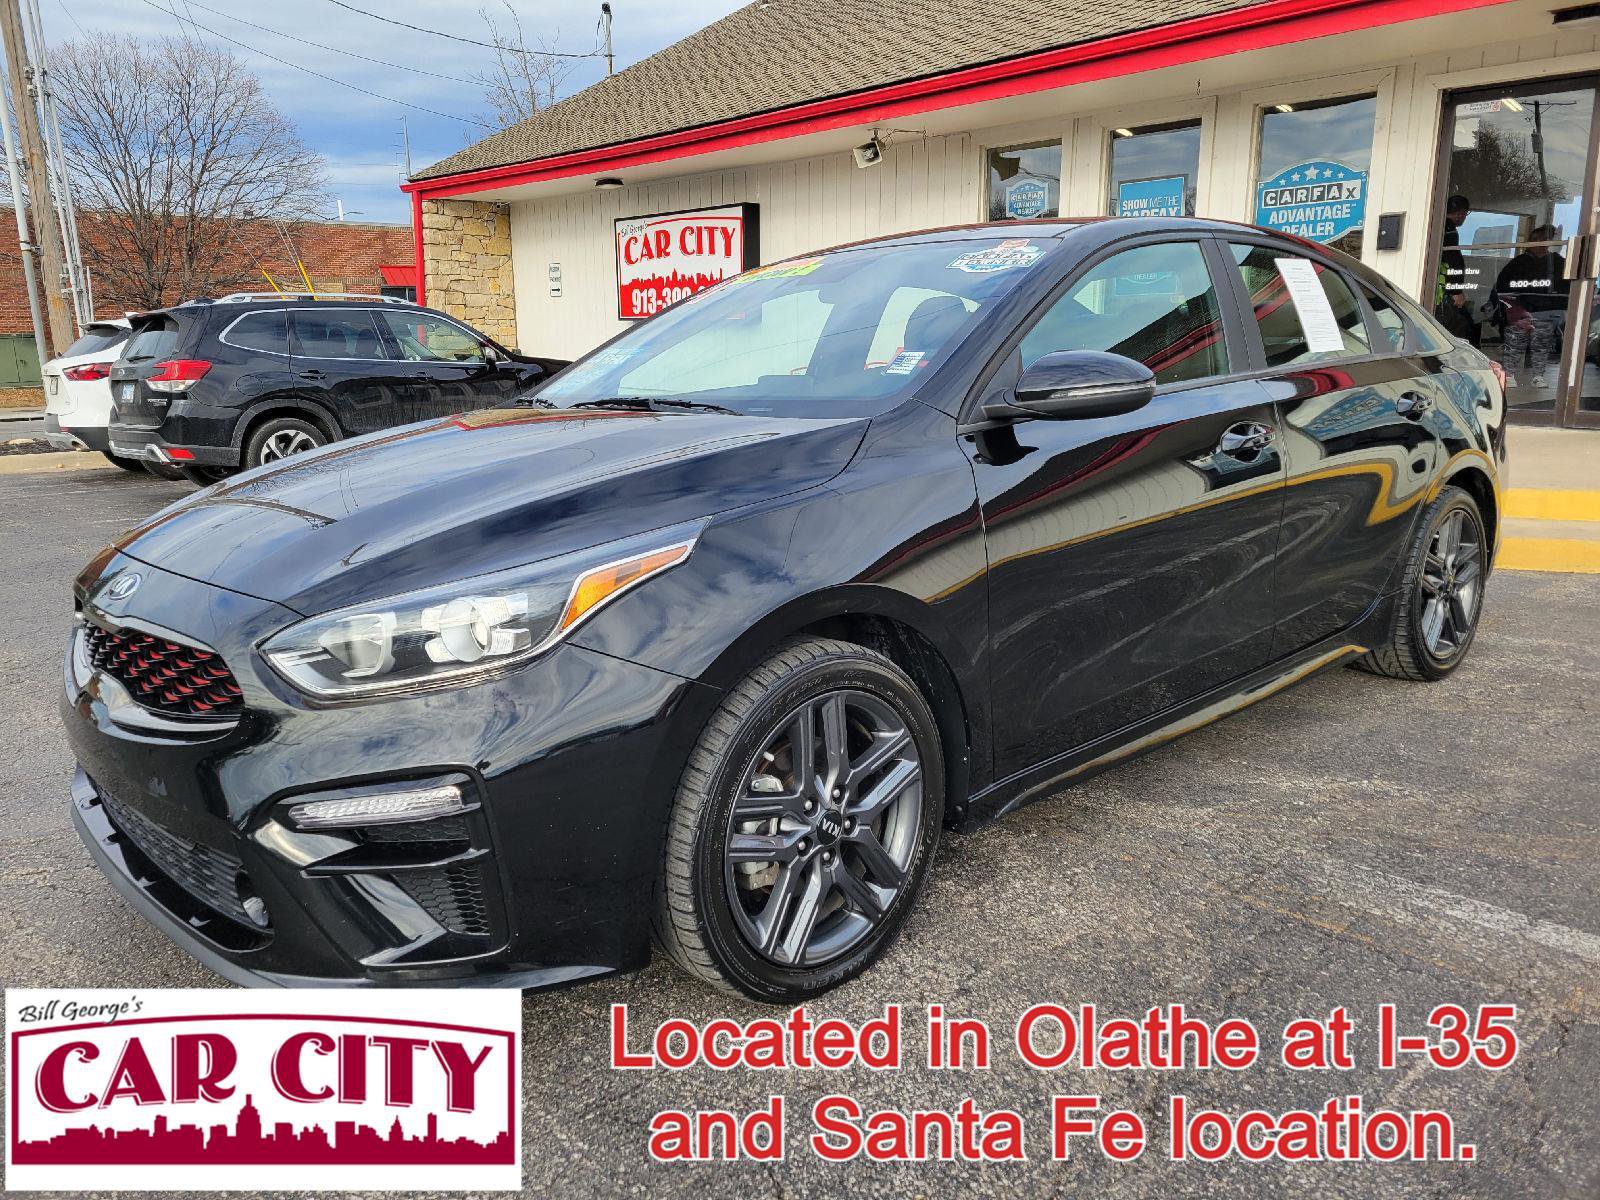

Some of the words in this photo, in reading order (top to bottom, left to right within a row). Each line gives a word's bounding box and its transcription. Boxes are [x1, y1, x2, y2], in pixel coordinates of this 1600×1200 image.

[1122, 199, 1148, 211] SHOW
[1149, 197, 1162, 208] ME
[1164, 195, 1180, 207] THE
[1265, 185, 1358, 205] CARFAX
[1268, 203, 1351, 224] ADVANTAGE
[1281, 221, 1335, 237] DEALER
[624, 229, 671, 266] CAR
[679, 225, 736, 258] CITY
[1445, 282, 1478, 290] Saturday
[1509, 279, 1551, 288] 9:00-6:00
